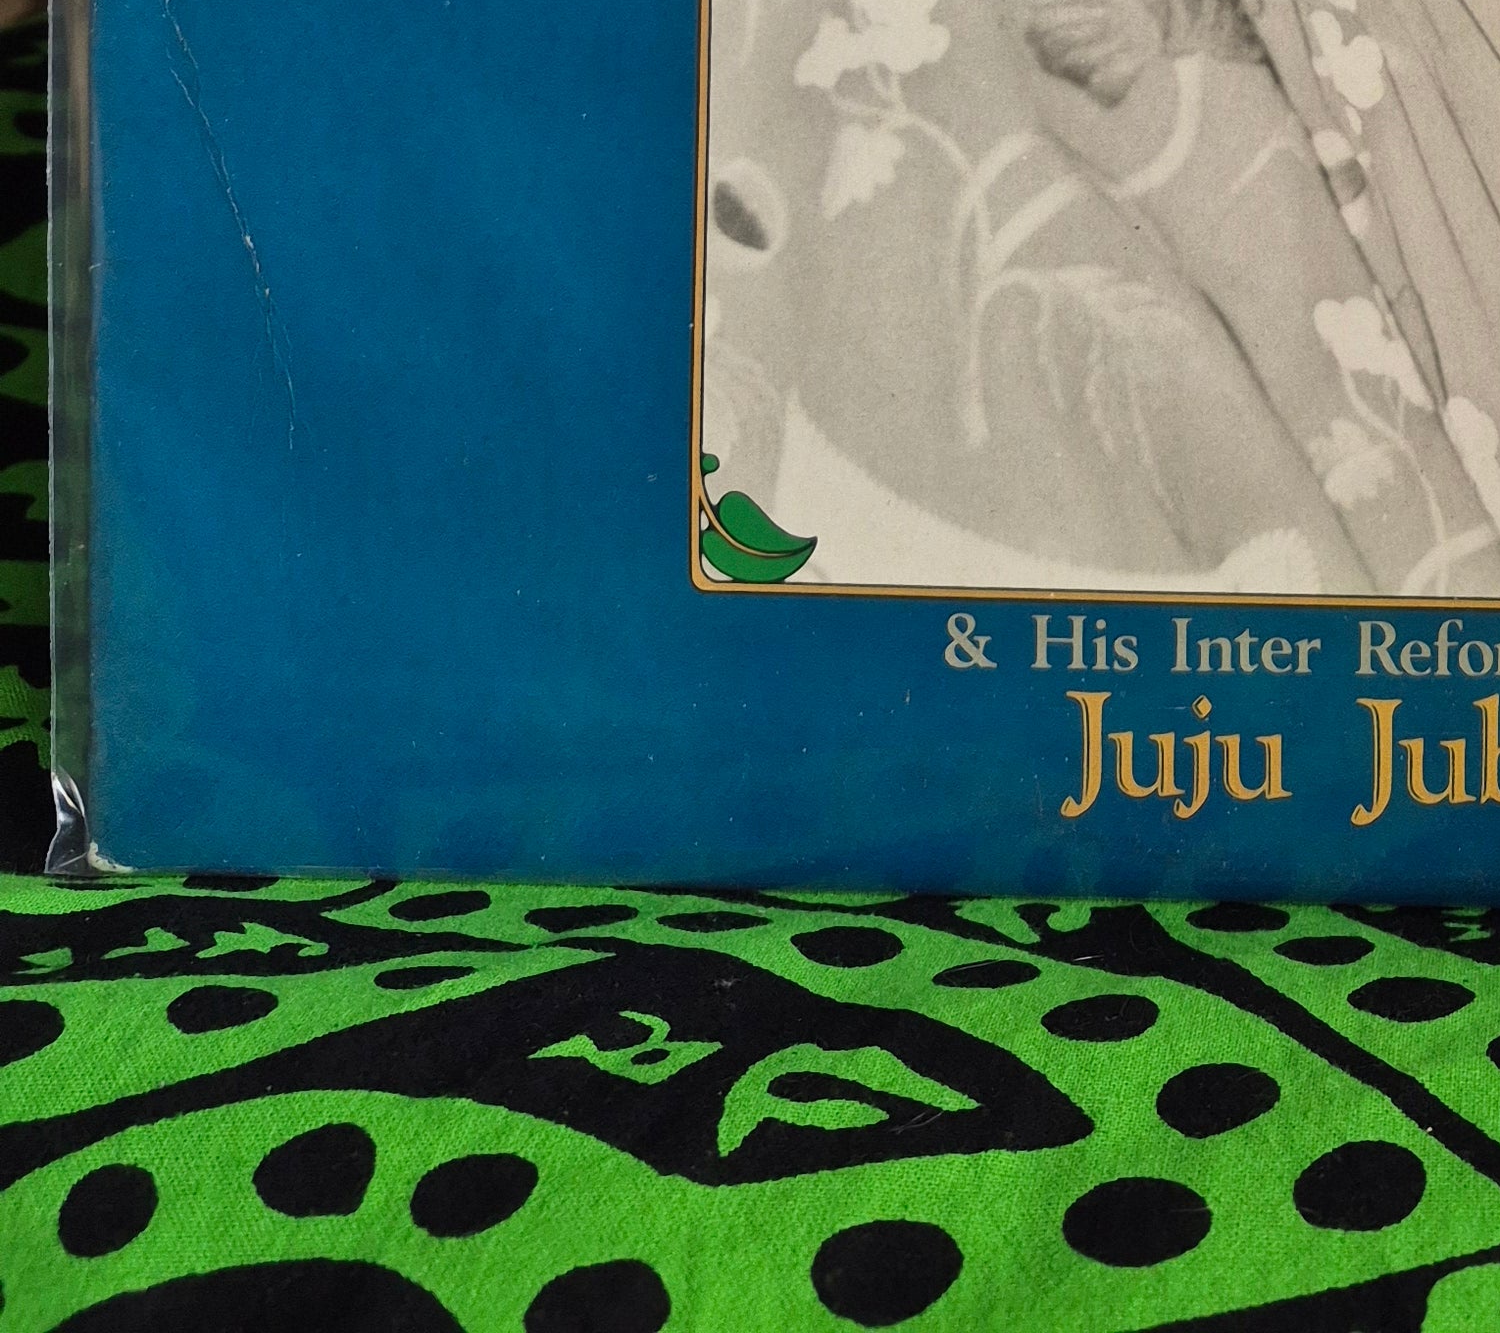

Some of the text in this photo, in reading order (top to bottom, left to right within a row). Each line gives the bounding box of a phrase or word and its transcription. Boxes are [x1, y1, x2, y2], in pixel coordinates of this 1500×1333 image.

[943, 612, 998, 671] &
[1030, 614, 1139, 673] His
[1170, 616, 1323, 675] Inter
[1060, 690, 1293, 821] Juju
